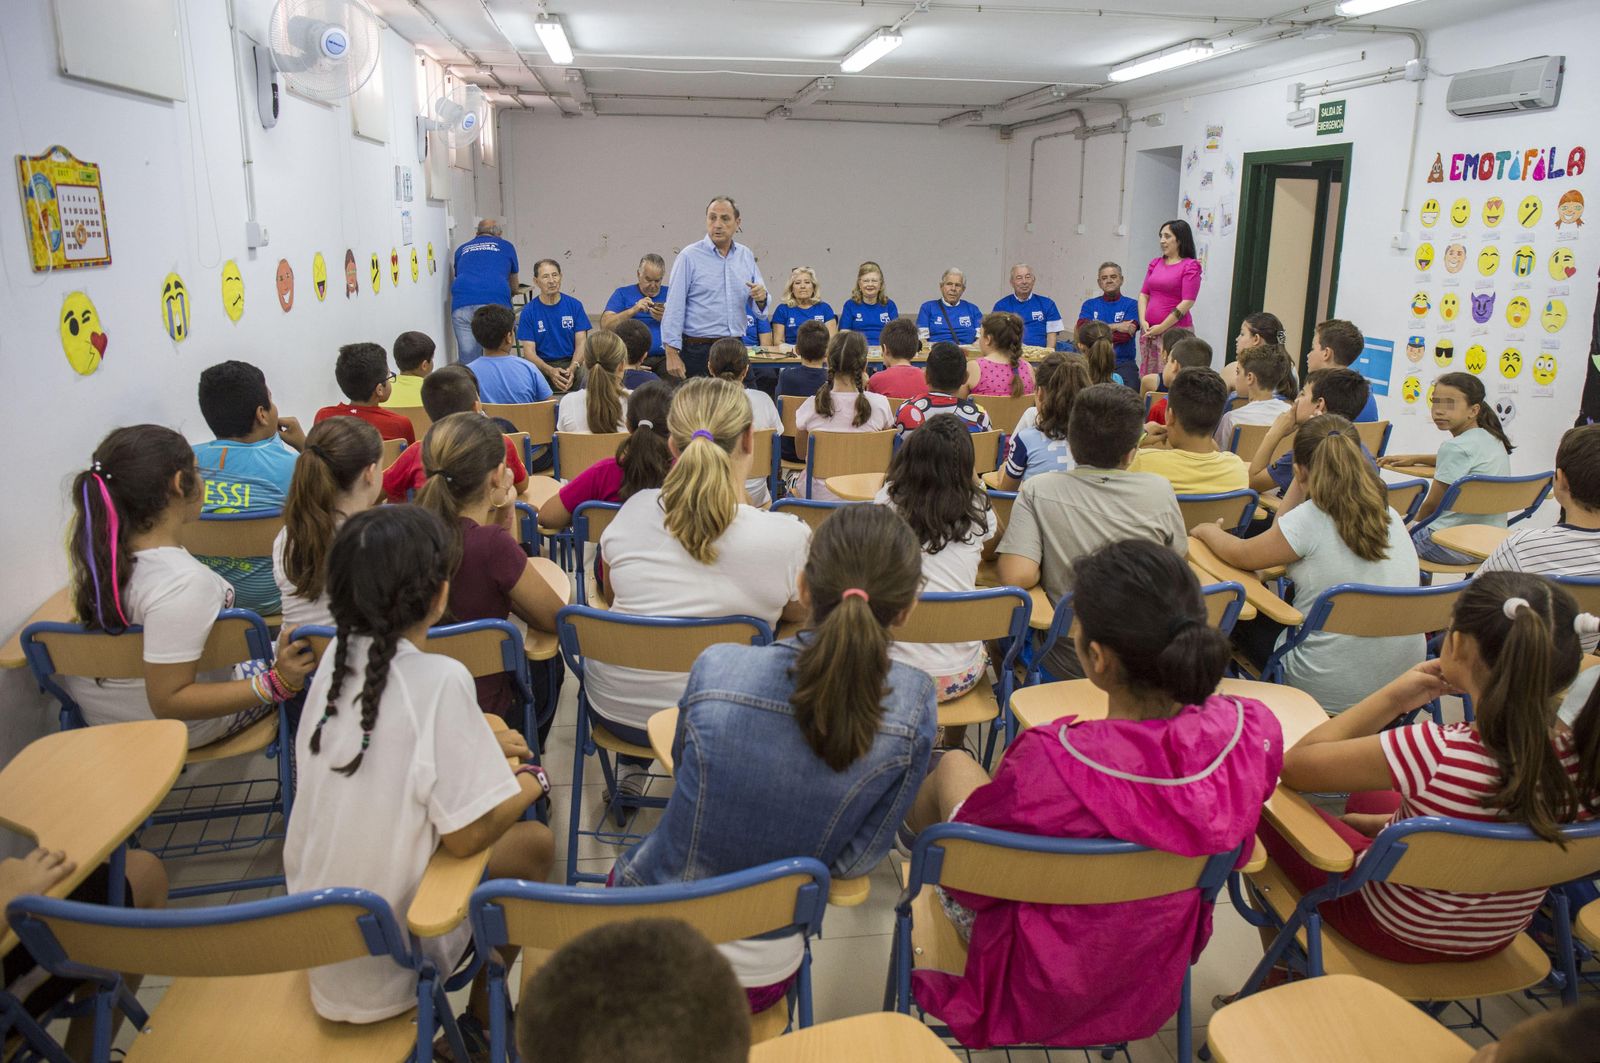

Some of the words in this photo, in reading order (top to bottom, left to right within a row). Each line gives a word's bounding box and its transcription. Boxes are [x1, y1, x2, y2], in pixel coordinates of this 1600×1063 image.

[1321, 107, 1335, 117] SALIDA
[1317, 119, 1344, 131] EMERGENCIA
[204, 480, 250, 507] ESSI
